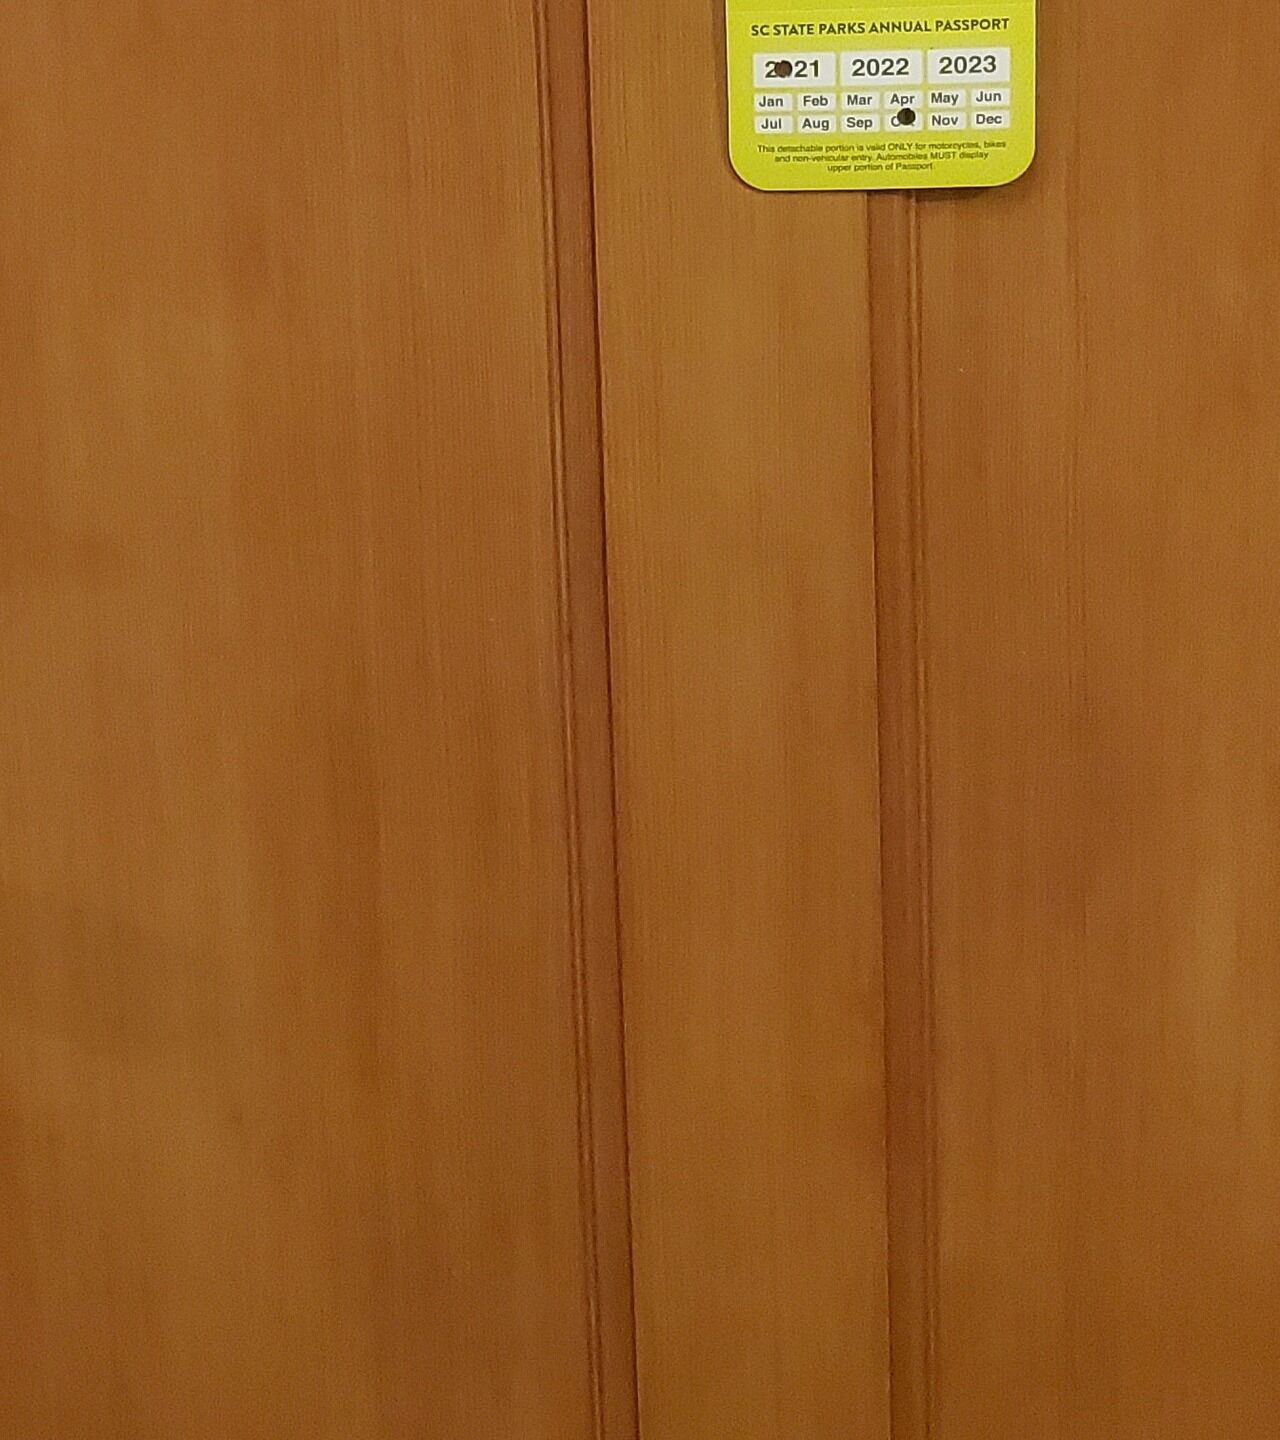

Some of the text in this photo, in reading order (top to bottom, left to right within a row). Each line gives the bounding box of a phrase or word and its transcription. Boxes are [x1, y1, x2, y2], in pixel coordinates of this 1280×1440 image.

[751, 18, 1009, 36] SC STATE PARKS ANNUAL PASSPORT
[764, 55, 997, 78] 221 2022 2023
[758, 91, 1002, 107] Jan Feb Mar Apr May Jun
[761, 114, 1002, 131] Jul Aug Sep Nov Dec
[757, 145, 775, 153] This
[777, 144, 823, 152] detachable
[825, 144, 854, 153] portion
[866, 143, 885, 151] valid
[888, 142, 913, 151] ONLY
[915, 142, 926, 150] for
[792, 154, 849, 162] non-vehicular
[876, 152, 928, 161] Automobiles
[930, 151, 957, 160] MUST
[959, 151, 988, 160] display
[827, 164, 851, 173] upper
[853, 163, 882, 172] portion
[885, 162, 894, 170] of
